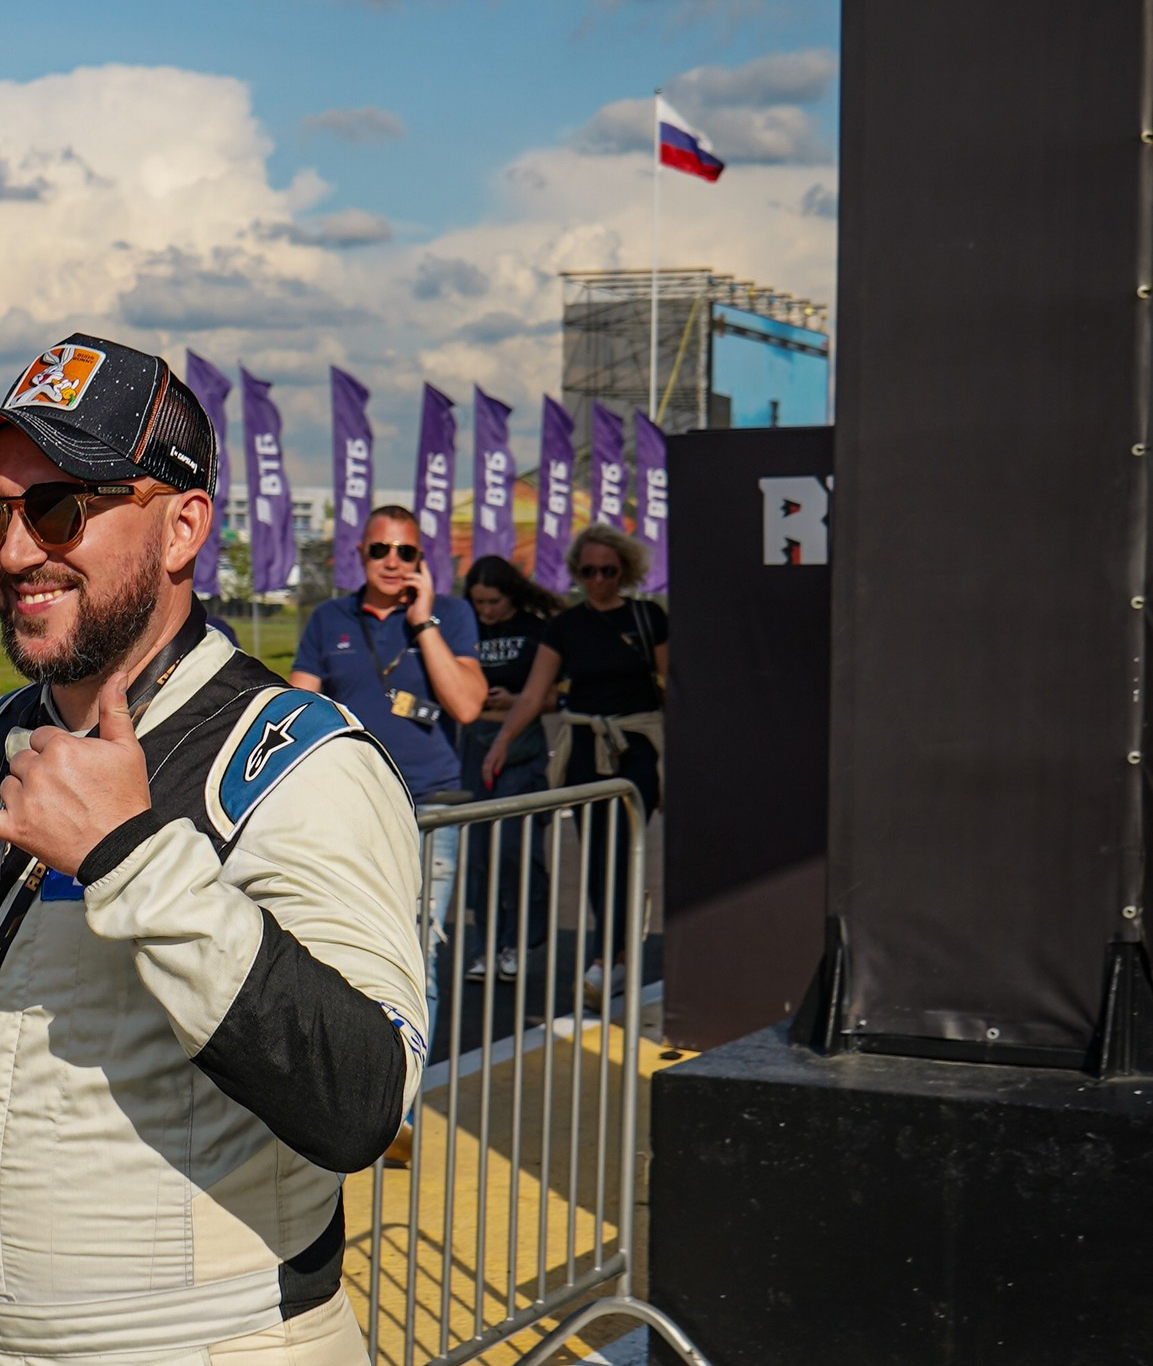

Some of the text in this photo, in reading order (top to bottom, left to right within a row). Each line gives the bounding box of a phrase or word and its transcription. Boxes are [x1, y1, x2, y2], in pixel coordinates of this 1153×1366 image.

[255, 433, 282, 495] ВТБ
[346, 438, 369, 499] ВТБ
[425, 452, 448, 512] ВТБ
[484, 450, 507, 507] ВТБ
[601, 462, 622, 515] ВТБ
[647, 467, 668, 519] ВТБ
[758, 475, 833, 565] R
[25, 861, 47, 892] RD
